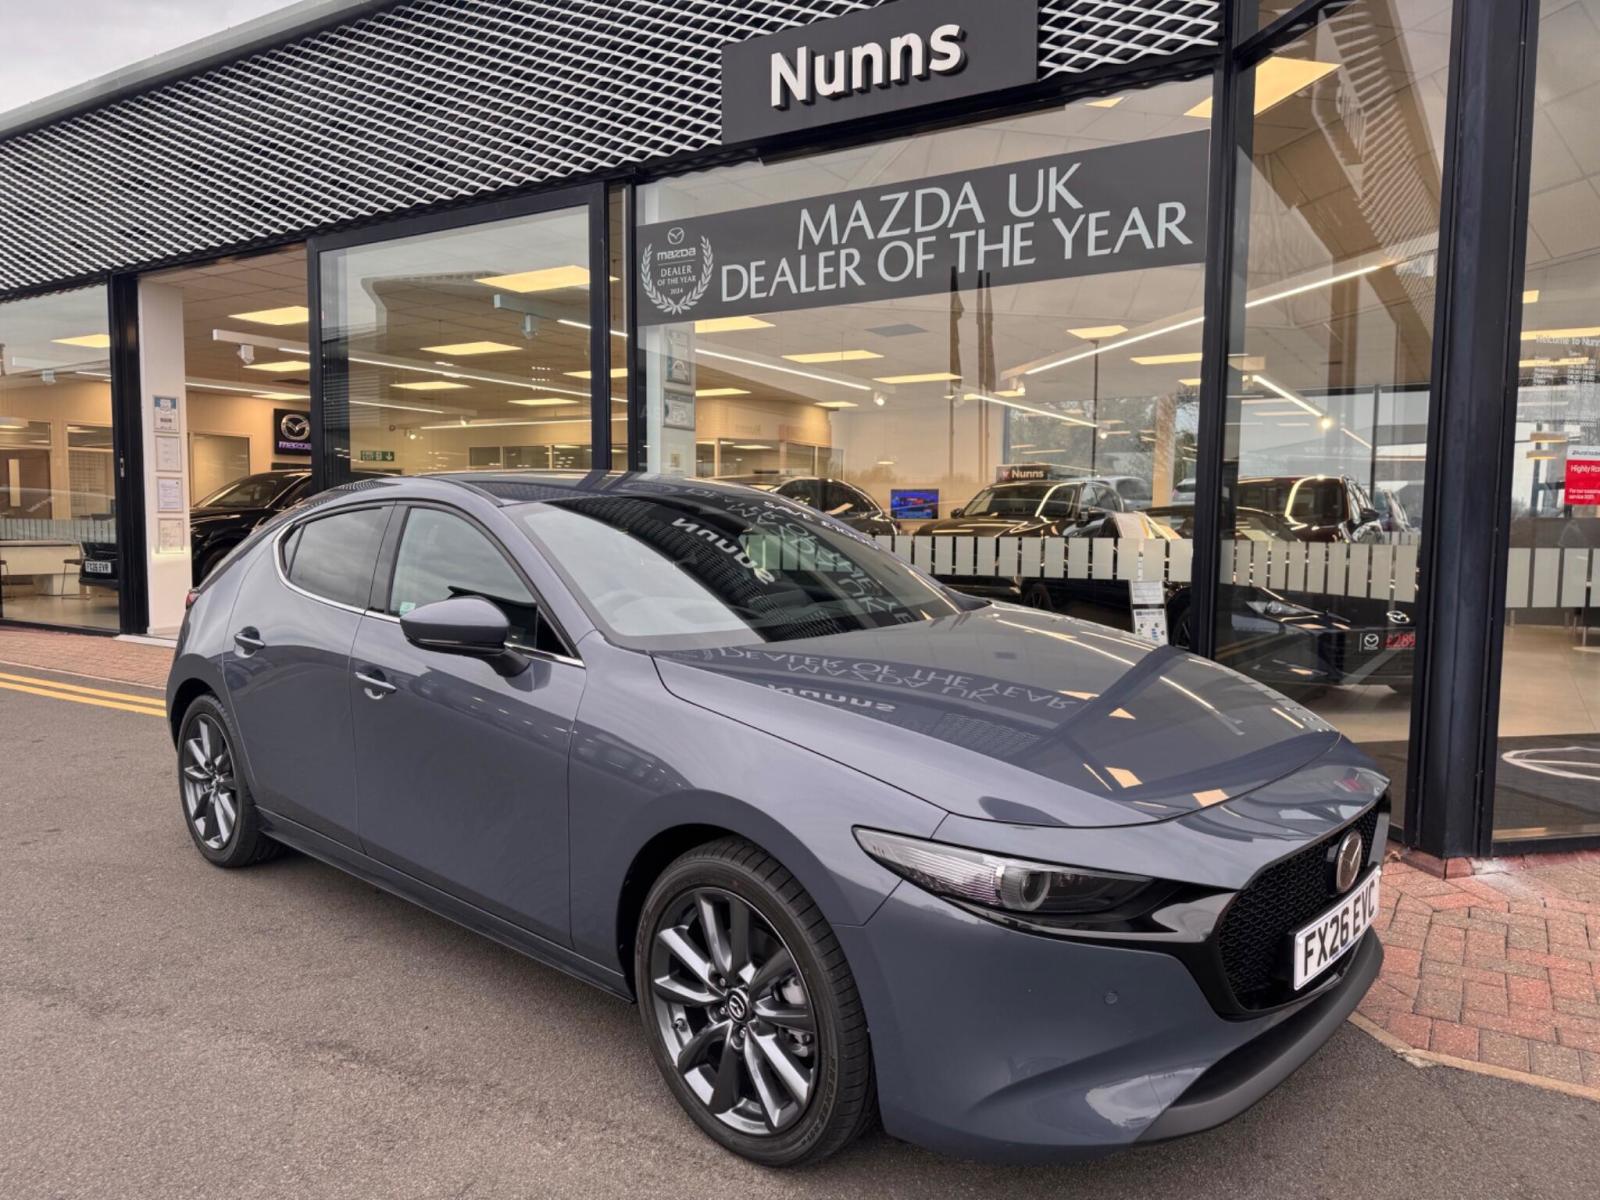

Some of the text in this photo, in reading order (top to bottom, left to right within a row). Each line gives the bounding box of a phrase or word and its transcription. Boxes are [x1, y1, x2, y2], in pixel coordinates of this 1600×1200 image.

[771, 24, 963, 108] Nunns
[798, 162, 1084, 250] MAZDA UK
[660, 265, 693, 278] DEALER
[667, 277, 679, 285] THE
[680, 275, 697, 284] YEAR
[721, 201, 1193, 302] DEALER OF THE YEAR
[1011, 470, 1045, 479] Nunns
[1304, 880, 1375, 977] FX26 EVC
